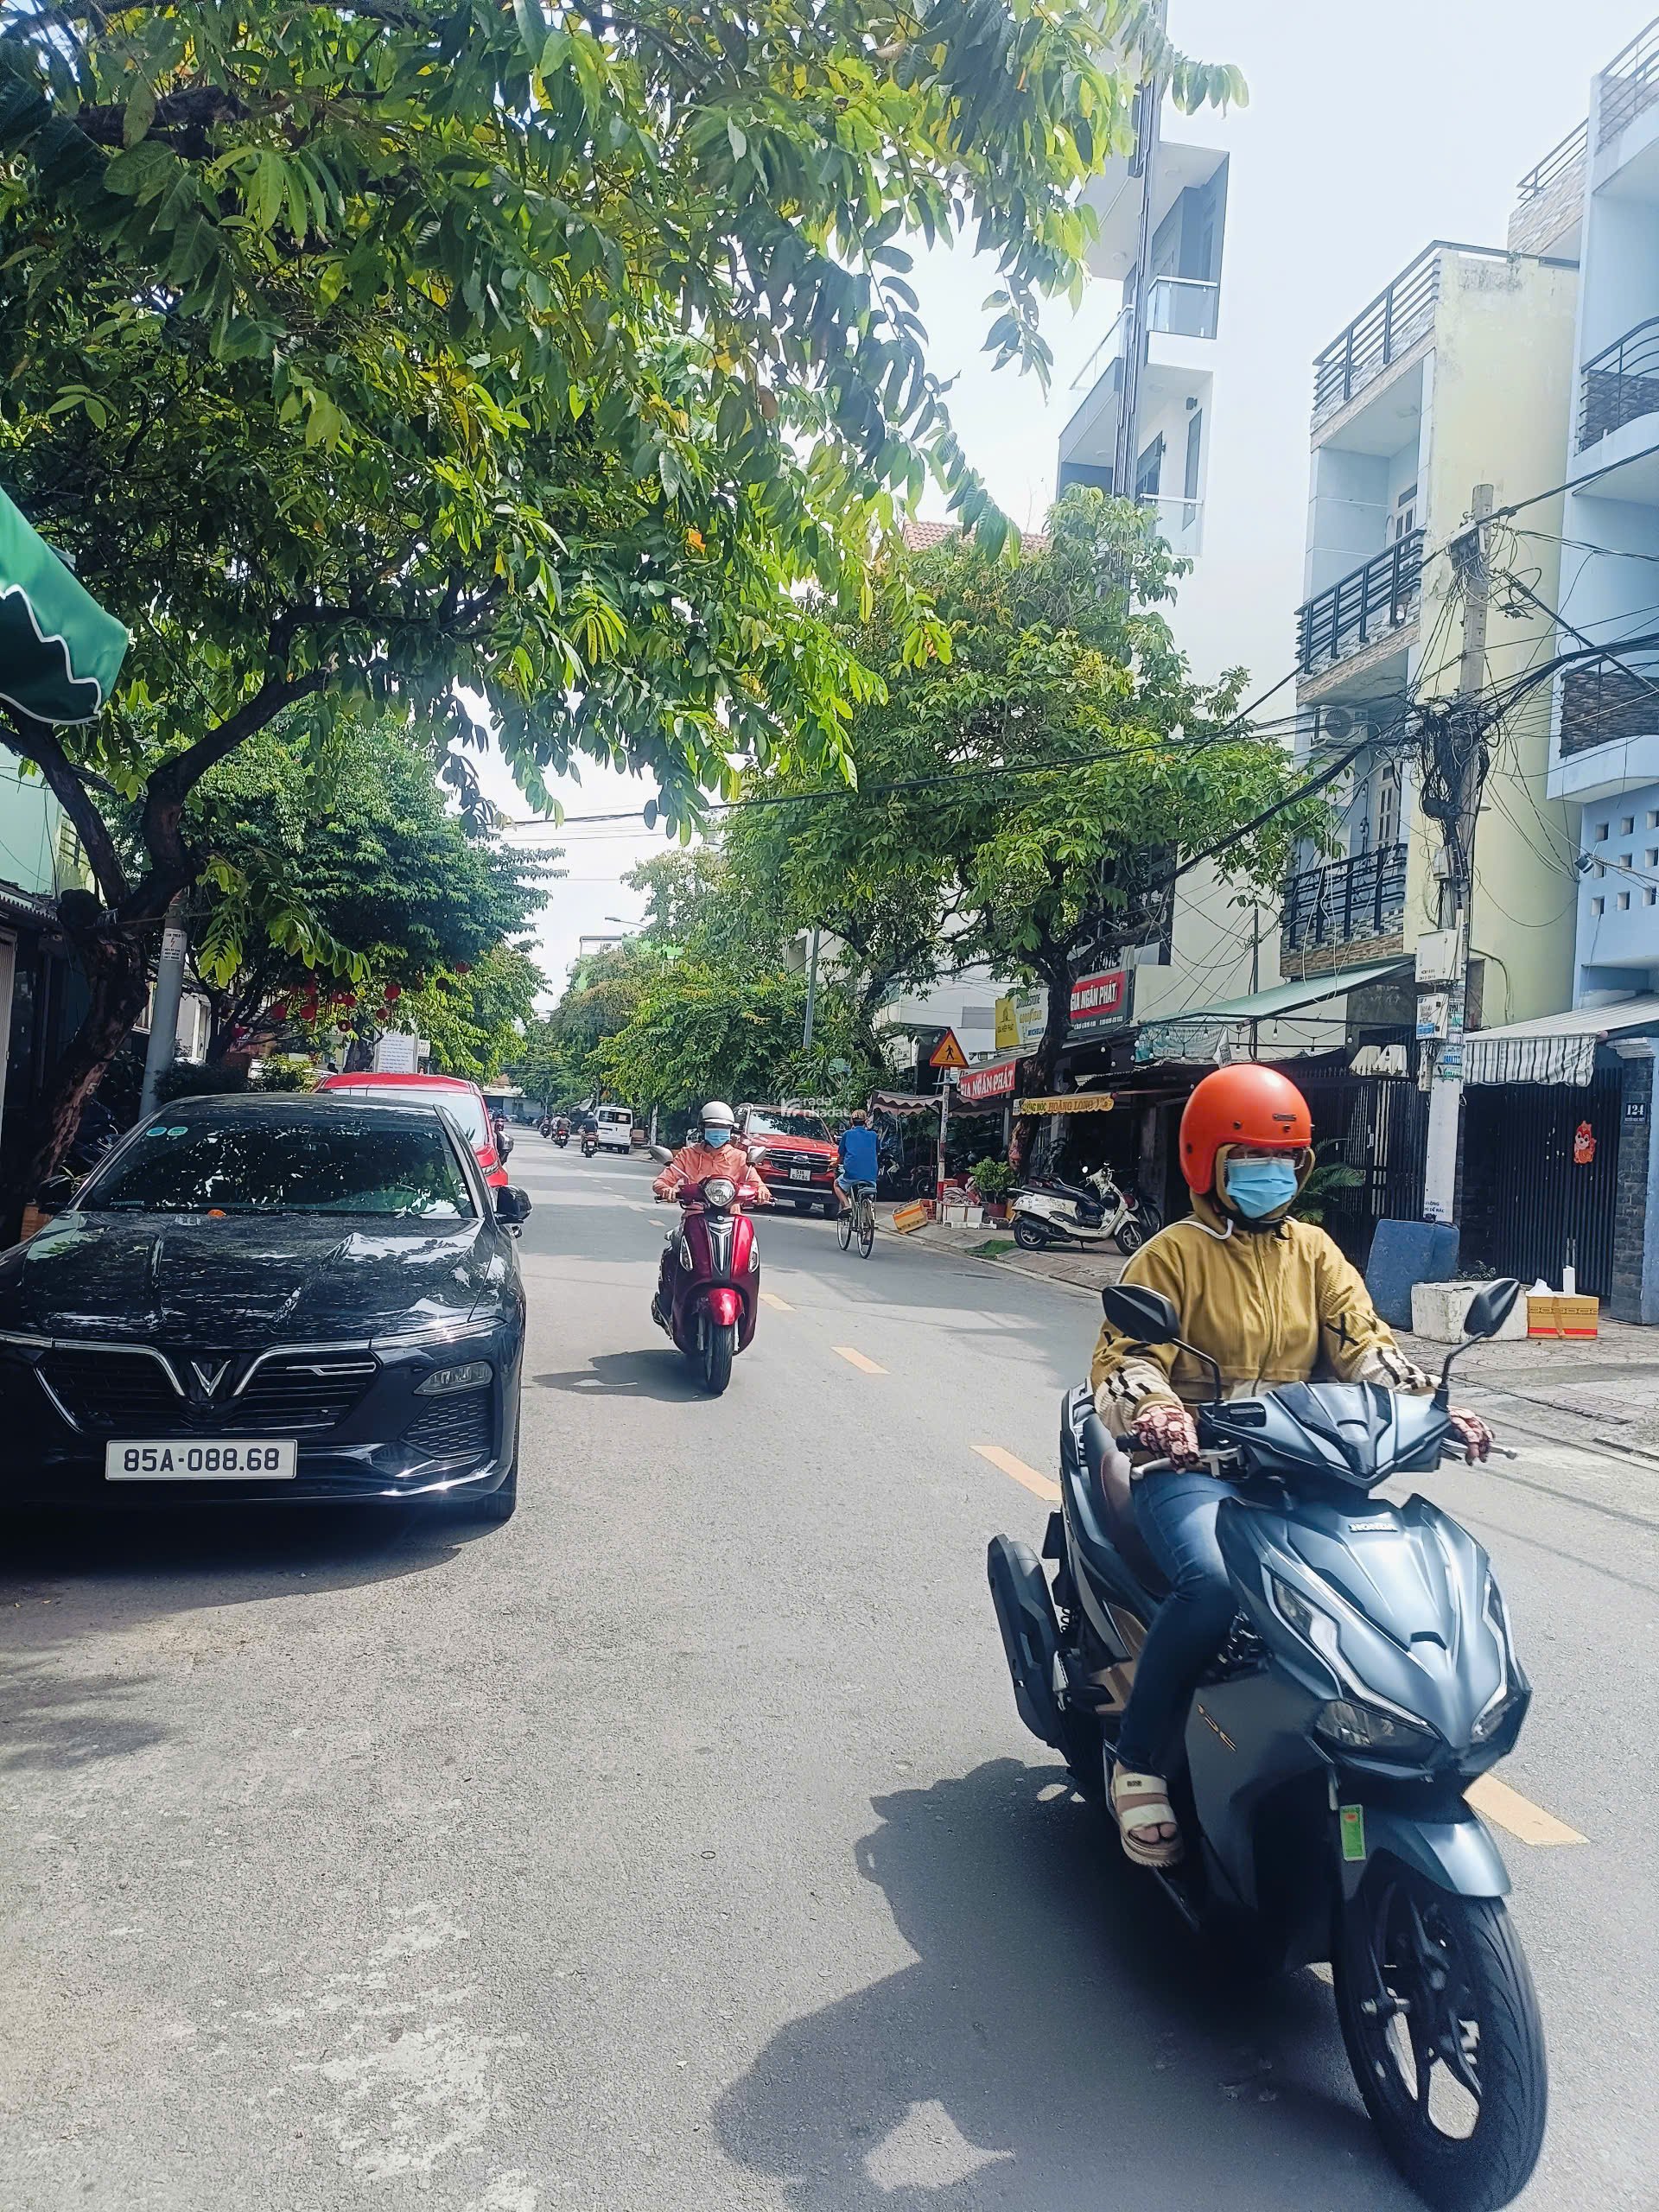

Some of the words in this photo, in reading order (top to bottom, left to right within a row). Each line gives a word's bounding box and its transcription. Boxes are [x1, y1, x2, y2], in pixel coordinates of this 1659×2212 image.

[1070, 991, 1080, 1011] GIA
[1080, 984, 1098, 1009] NGÂN
[1099, 979, 1117, 1005] PHÁT
[972, 1072, 992, 1096] NGÂN
[993, 1065, 1014, 1092] PHÁT
[1627, 1104, 1643, 1116] 124
[124, 1447, 280, 1471] 85A-088.68
